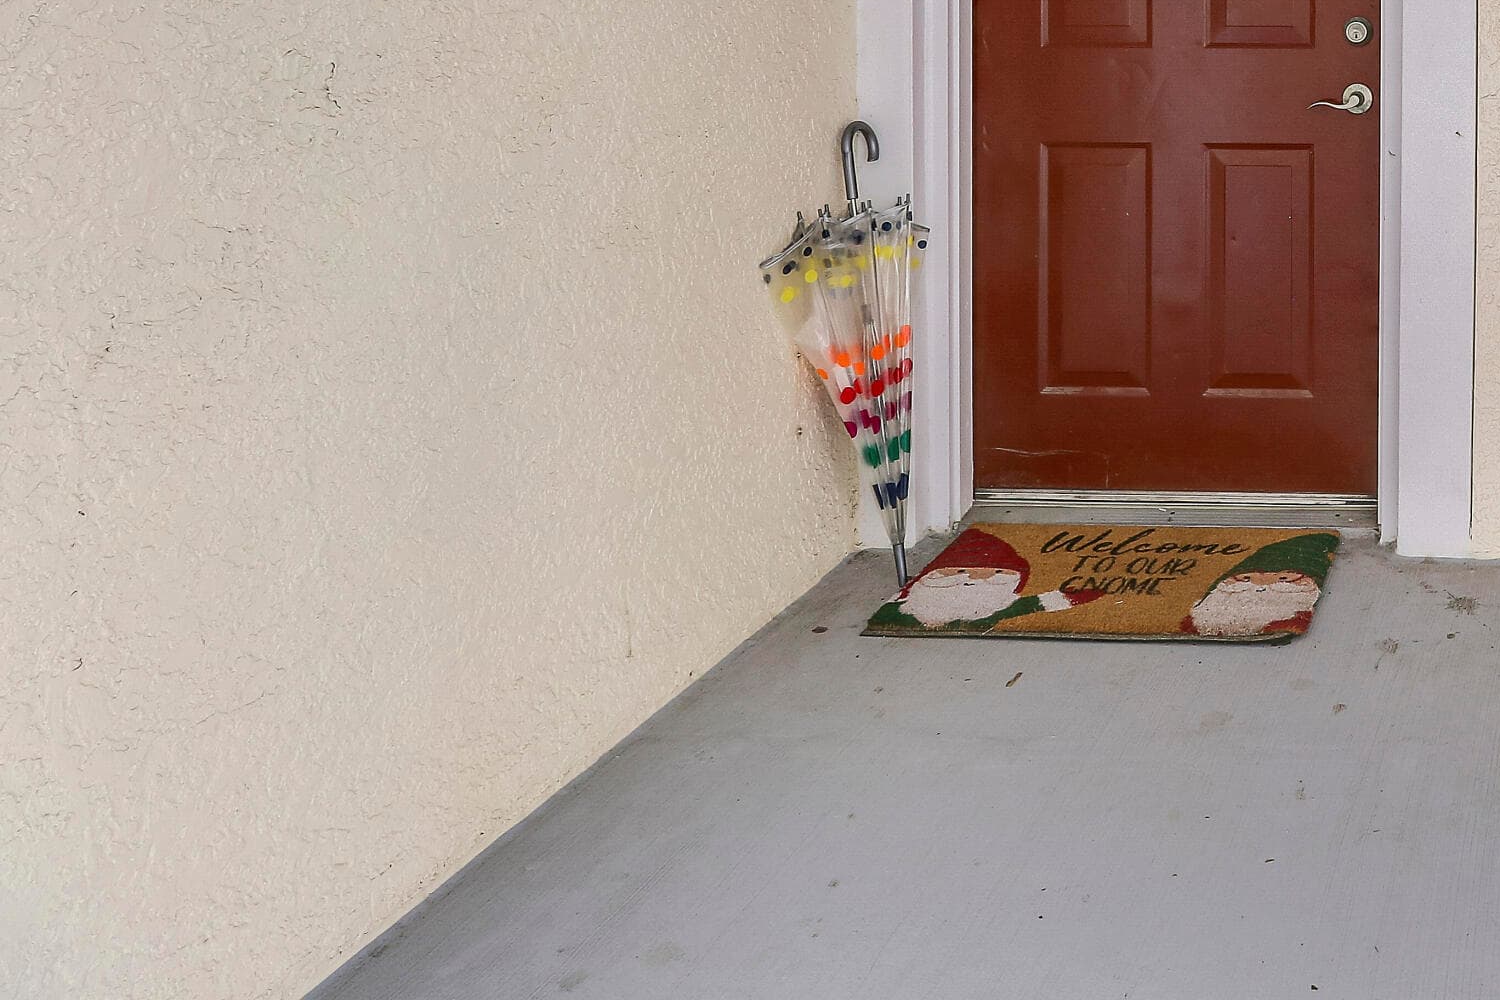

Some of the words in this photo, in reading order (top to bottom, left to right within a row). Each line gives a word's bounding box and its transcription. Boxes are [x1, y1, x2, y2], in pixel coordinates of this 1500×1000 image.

[1040, 528, 1251, 556] Welcome
[1072, 554, 1116, 573] TO
[1125, 556, 1198, 576] OUR
[1058, 575, 1176, 596] GNOME
